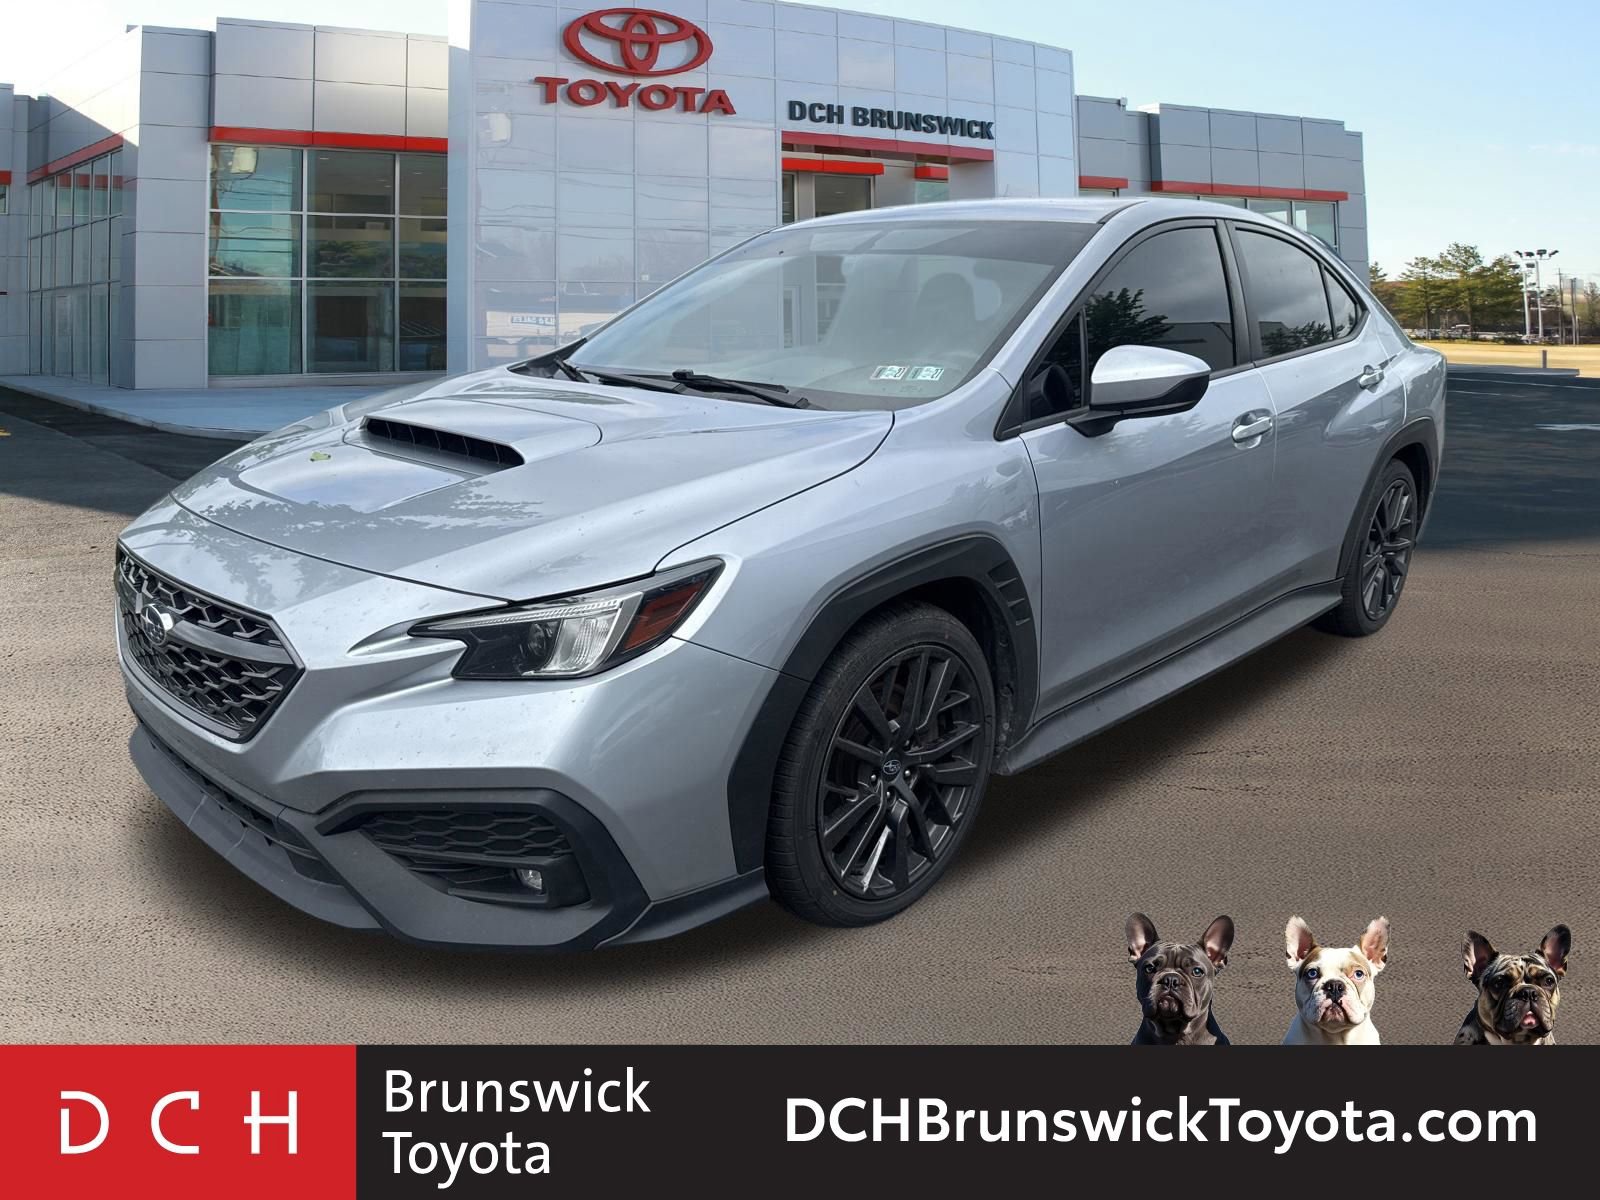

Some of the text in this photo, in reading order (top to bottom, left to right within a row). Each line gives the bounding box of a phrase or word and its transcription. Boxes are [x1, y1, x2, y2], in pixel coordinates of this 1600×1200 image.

[533, 76, 736, 115] TOYOTA
[788, 100, 995, 140] DCH BRUNSWICK
